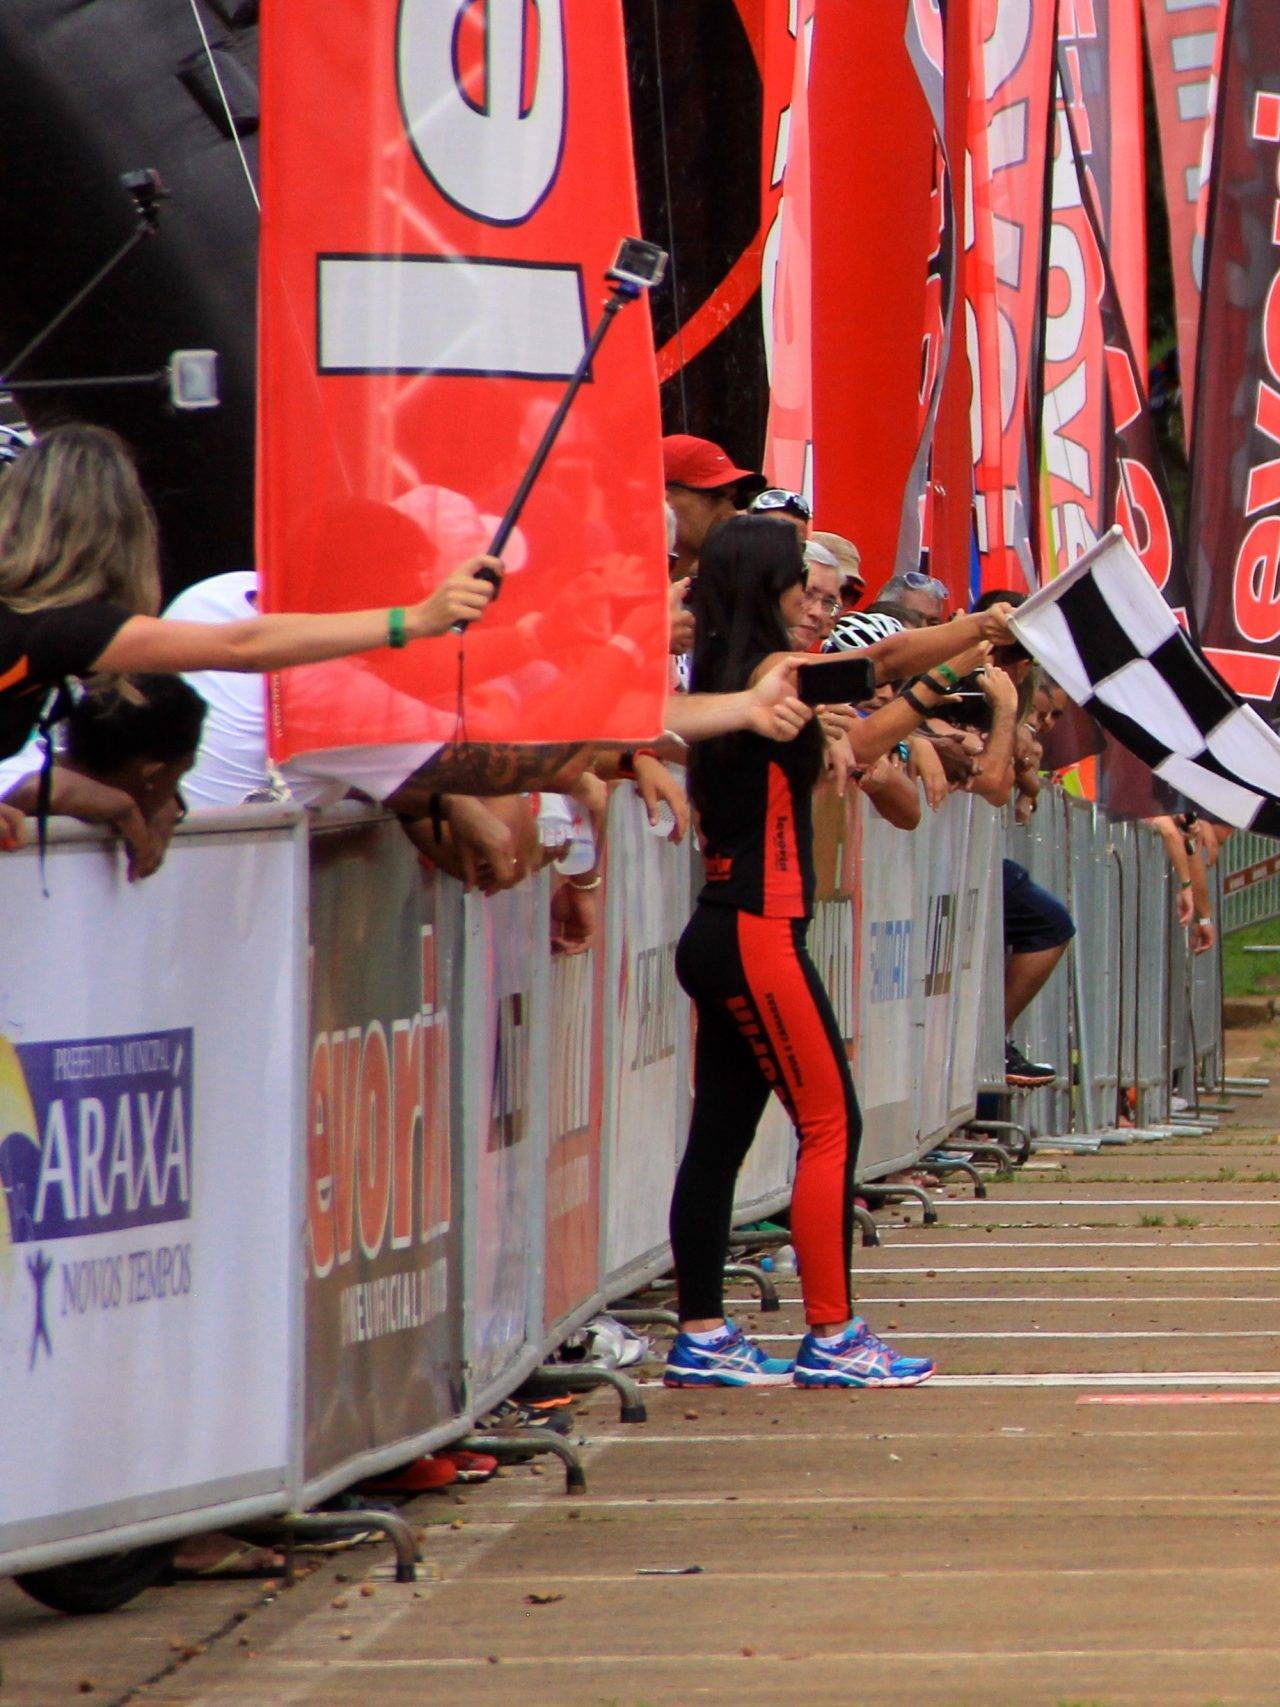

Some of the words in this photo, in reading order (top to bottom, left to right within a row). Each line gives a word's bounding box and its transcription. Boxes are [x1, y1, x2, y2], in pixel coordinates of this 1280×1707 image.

[54, 1044, 121, 1081] PREFEITURA
[33, 1042, 190, 1225] ARAXÁ
[60, 1253, 123, 1317] NOVOS
[127, 1242, 193, 1305] TEMPOS
